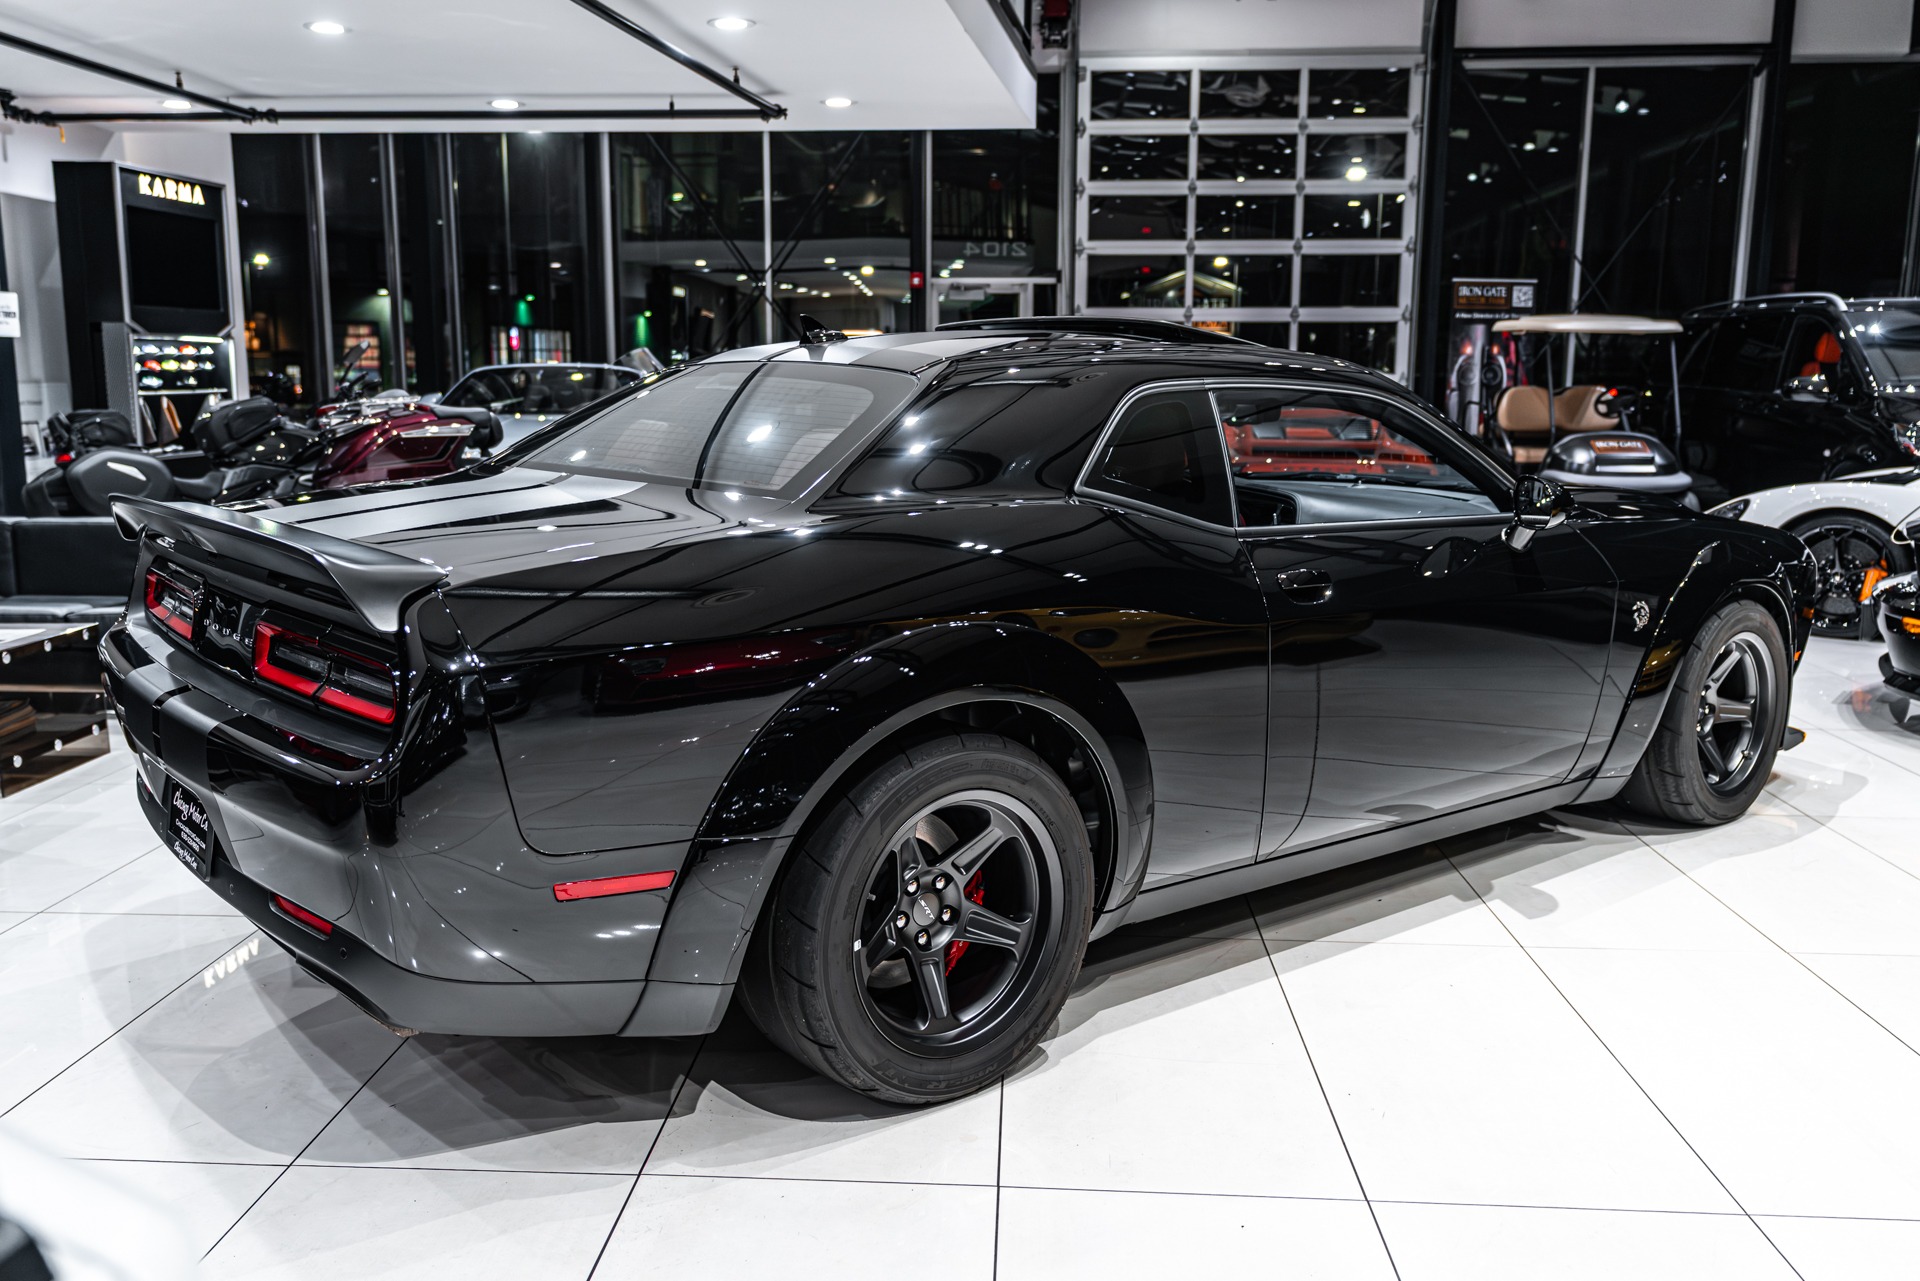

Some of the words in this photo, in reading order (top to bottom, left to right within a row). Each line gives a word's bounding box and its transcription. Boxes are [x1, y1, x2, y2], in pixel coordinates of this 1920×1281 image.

[138, 172, 205, 205] KARMA
[1458, 286, 1482, 297] IRON
[1483, 287, 1507, 298] GATE
[203, 618, 254, 647] DODGE
[918, 895, 935, 920] SRT
